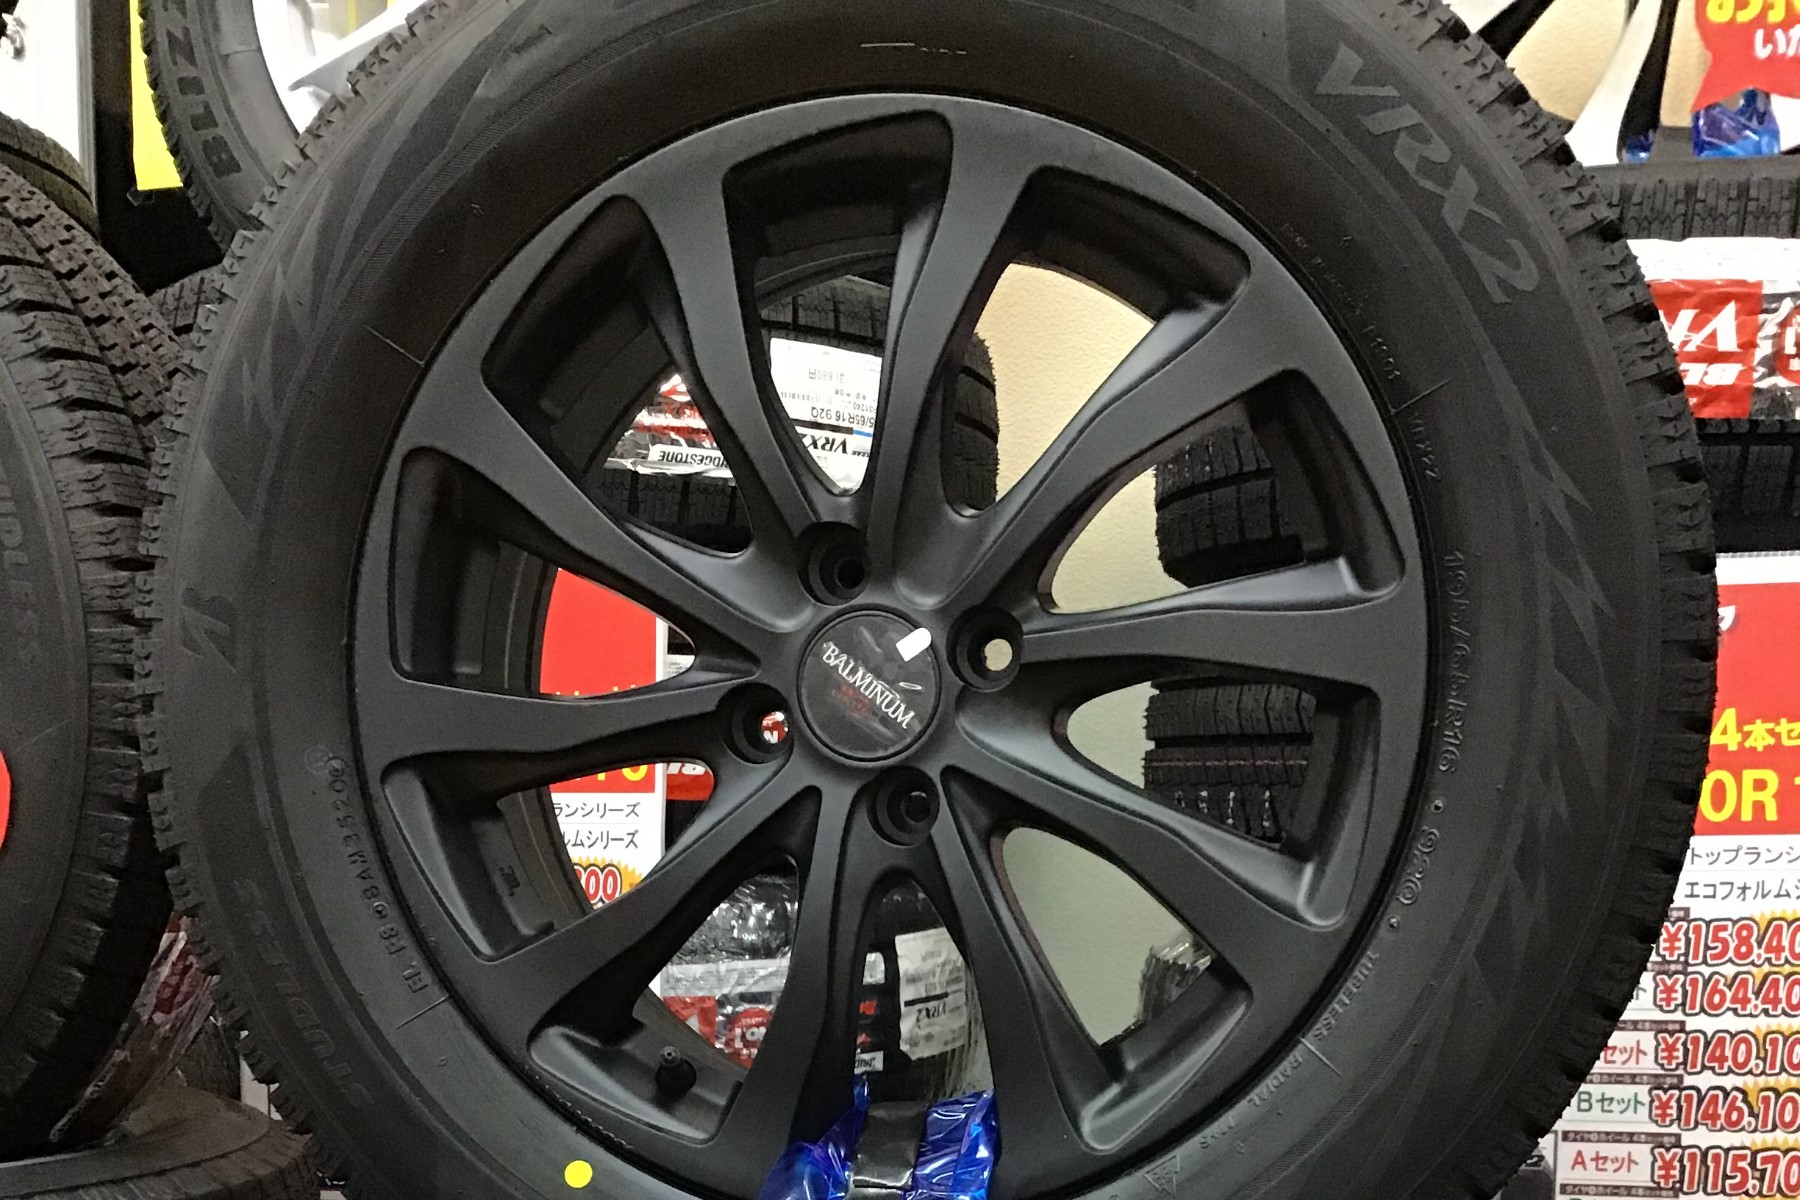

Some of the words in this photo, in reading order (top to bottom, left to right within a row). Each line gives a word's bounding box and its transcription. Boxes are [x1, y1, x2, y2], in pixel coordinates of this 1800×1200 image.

[1315, 42, 1539, 304] VRX2
[822, 641, 916, 730] BALMINUM
[1437, 551, 1472, 775] 195/65R16
[1576, 1089, 1646, 1117] Bセット
[1570, 1148, 1640, 1174] Aセット
